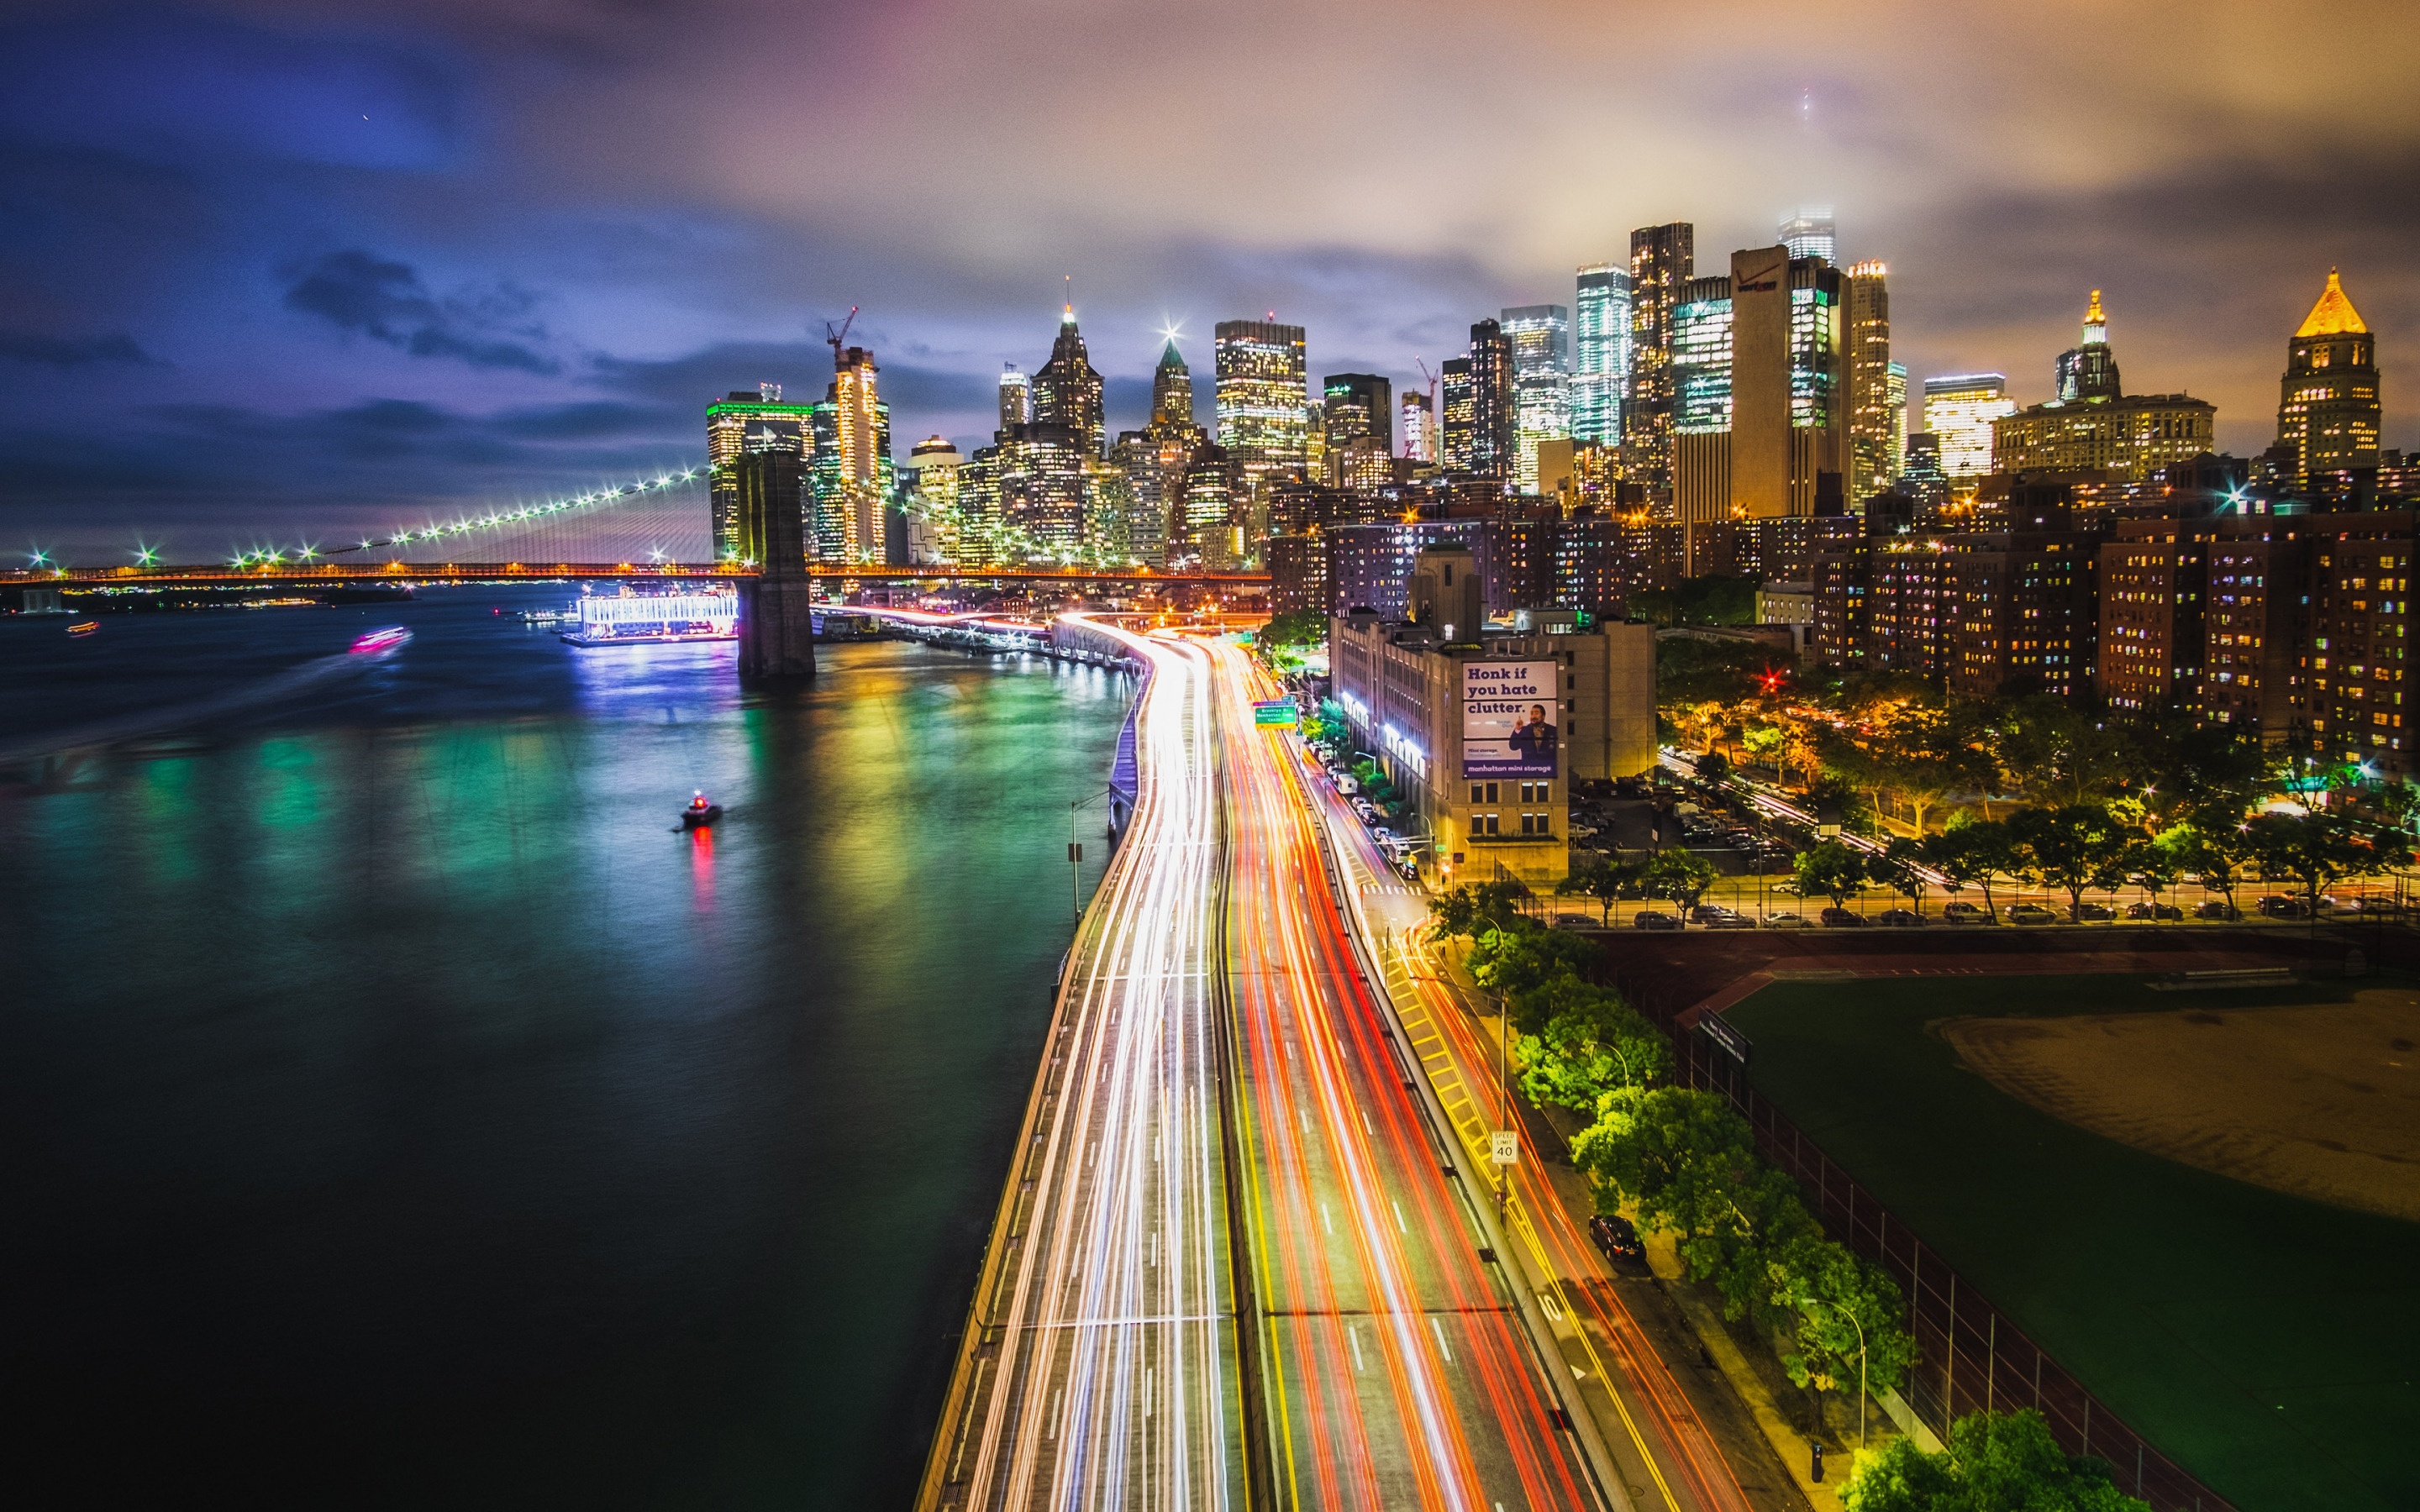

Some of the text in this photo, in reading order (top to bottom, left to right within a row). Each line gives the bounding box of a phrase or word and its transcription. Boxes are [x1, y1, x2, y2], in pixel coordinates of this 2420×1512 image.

[1738, 281, 1777, 292] verizon
[1468, 668, 1528, 680] Honk if
[1468, 684, 1537, 698] you hate
[1468, 703, 1526, 713] clutter.
[1497, 1147, 1512, 1156] 40
